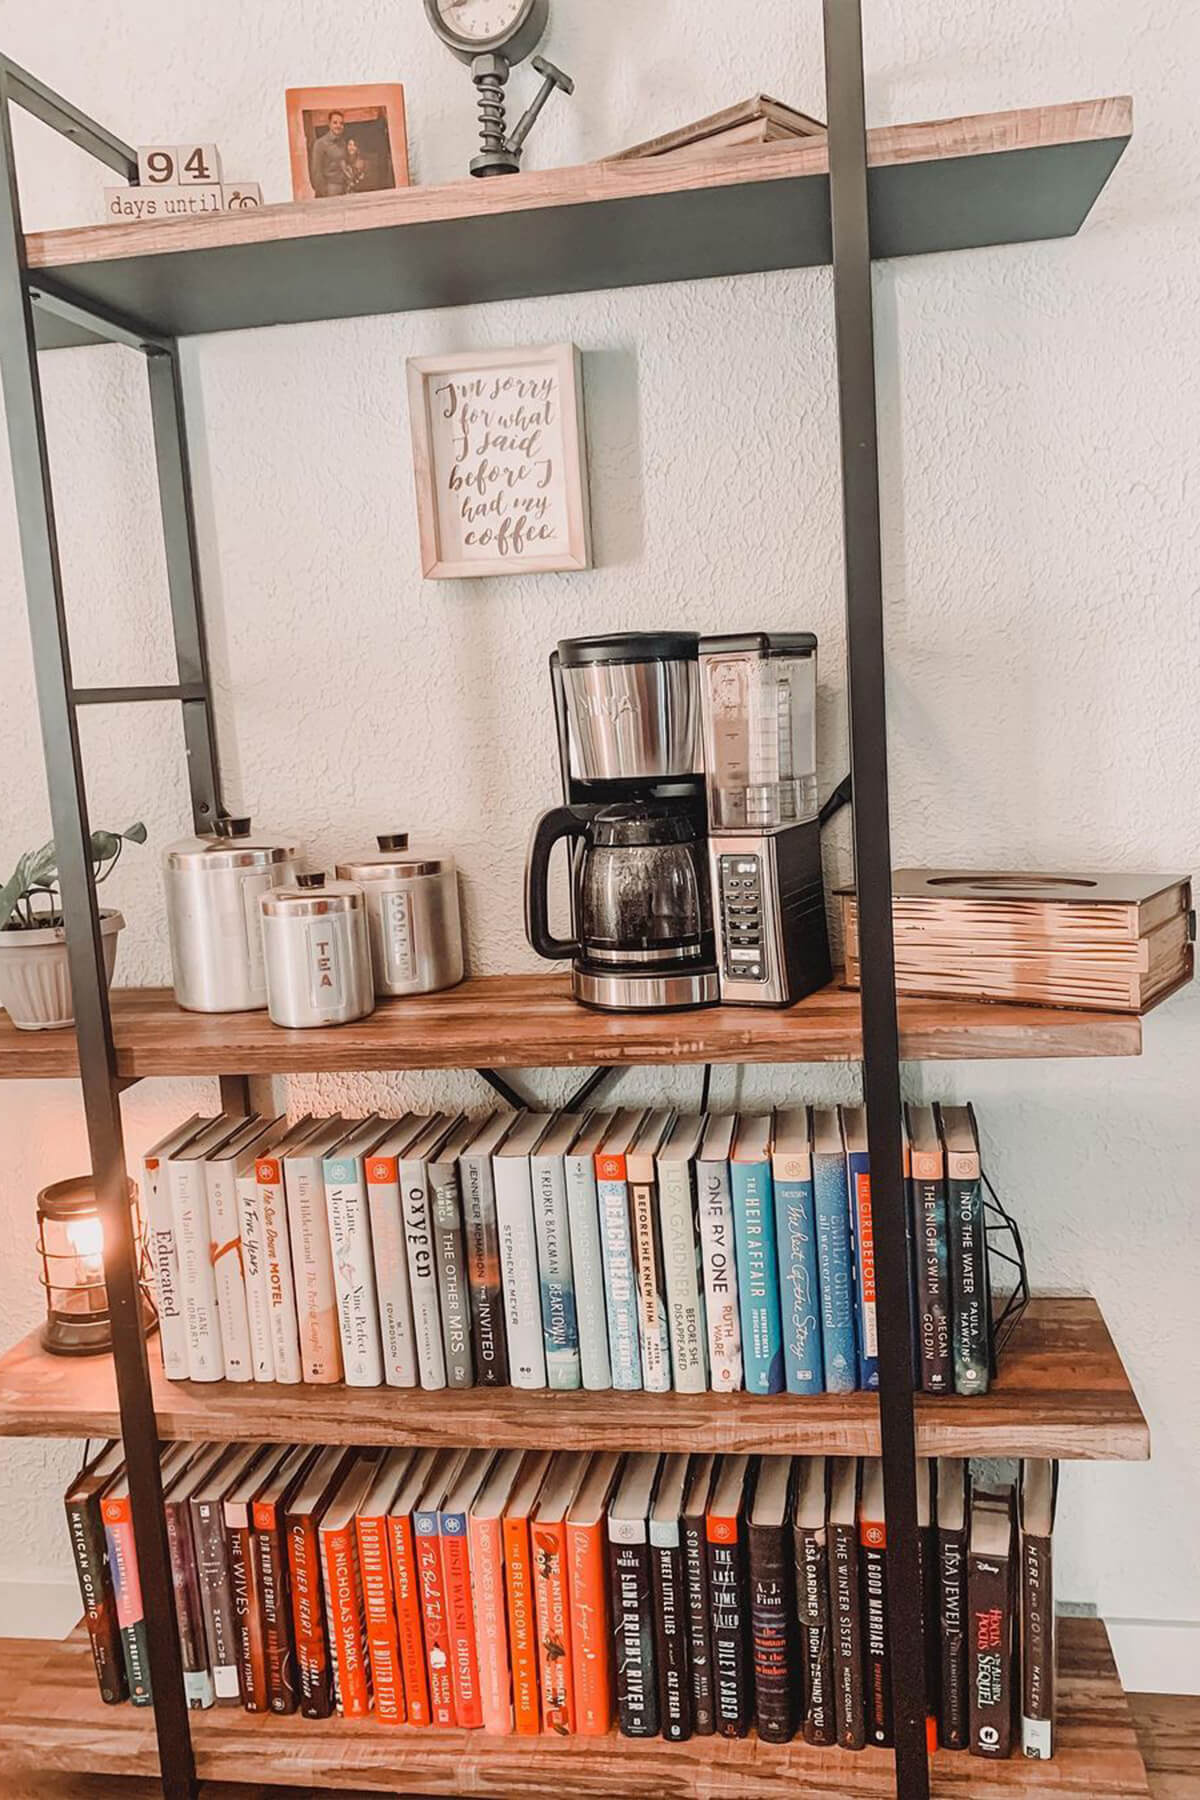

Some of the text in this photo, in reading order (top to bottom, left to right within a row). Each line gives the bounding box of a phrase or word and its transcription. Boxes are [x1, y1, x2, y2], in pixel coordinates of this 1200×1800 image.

[146, 147, 210, 182] 94
[110, 193, 221, 218] days until
[489, 377, 556, 399] sorry
[460, 400, 553, 436] for what
[453, 429, 541, 462] I said
[449, 459, 552, 495] before I
[461, 492, 550, 522] had my
[464, 516, 555, 555] coffee
[316, 942, 333, 988] TEA
[263, 1189, 273, 1208] The
[445, 1190, 453, 1217] MARY
[469, 1163, 482, 1219] JENNIFER
[243, 1198, 259, 1275] In Five Years
[265, 1209, 276, 1226] Sun
[407, 1188, 431, 1278] oxygen
[541, 1170, 559, 1274] FREDRIK BACKMAN
[745, 1177, 765, 1297] THE HEIR AFFAIR
[860, 1201, 872, 1235] GIRL
[266, 1229, 277, 1258] Down
[637, 1193, 654, 1324] BEFORE SHE KNEW HIM
[924, 1185, 938, 1295] THE NIGHT SWIM
[960, 1191, 973, 1294] INTO THE WATER
[156, 1230, 180, 1317] Educated
[270, 1263, 282, 1308] MOTEL
[504, 1224, 518, 1325] STEPHENIE MEYER
[609, 1258, 630, 1301] READ
[711, 1253, 729, 1293] ONE
[819, 1214, 834, 1328] all we ever wanted
[863, 1240, 876, 1297] BEFORE
[443, 1232, 464, 1355] THE OTHER MRS.
[197, 1307, 209, 1336] LIANE
[342, 1294, 354, 1346] Strangers
[479, 1303, 494, 1361] INVITED
[549, 1283, 566, 1345] BEARTOWN
[722, 1306, 733, 1337] RUTH
[969, 1301, 978, 1335] PAULA
[356, 1316, 367, 1354] Perfect
[673, 1303, 687, 1371] DISAPPEARED
[686, 1308, 698, 1366] BEFORE SHE
[714, 1324, 724, 1358] WARE
[923, 1313, 934, 1360] GOLDIN
[938, 1316, 948, 1358] MEGAN
[960, 1312, 970, 1362] HAWKINS
[71, 1511, 97, 1620] MEXICAN GOTHIC
[231, 1534, 249, 1616] THE WIVES
[261, 1554, 271, 1574] KIND
[536, 1548, 548, 1572] FOR
[660, 1550, 672, 1579] SWEET
[686, 1530, 700, 1610] SOMETIMES
[714, 1549, 732, 1563] THE
[867, 1552, 880, 1560] A
[944, 1543, 961, 1576] LISA
[1027, 1545, 1039, 1587] HERE
[264, 1576, 272, 1586] OF
[293, 1526, 312, 1636] CROSS HER HEART
[398, 1558, 409, 1599] LAPENA
[551, 1552, 564, 1636] THE ANTIDOTE
[662, 1582, 674, 1612] LITTLE
[712, 1570, 736, 1584] LAST
[756, 1582, 782, 1594] A. J.
[804, 1537, 819, 1617] LISA GARDNER
[836, 1536, 852, 1657] THE WINTER SISTER
[868, 1564, 881, 1595] GOOD
[335, 1553, 358, 1671] NICHOLAS SPARKS
[511, 1561, 527, 1650] BREAKDOWN
[713, 1592, 737, 1605] TIME
[757, 1594, 781, 1605] Finn
[664, 1614, 676, 1635] LIES
[692, 1625, 704, 1648] LIE
[712, 1613, 719, 1626] I
[869, 1599, 884, 1656] MARRIAGE
[989, 1608, 1002, 1647] HOCUS
[241, 1626, 253, 1692] TARRYN FISHER
[618, 1574, 644, 1711] LONG BRIGHT RIVER
[441, 1675, 451, 1704] HELEN
[520, 1682, 530, 1711] PARIS
[668, 1670, 678, 1688] CAZ
[716, 1640, 738, 1719] RILEY SAGER
[843, 1667, 854, 1721] MEGAN COLLINS
[976, 1653, 996, 1709] SEQUEL
[669, 1690, 680, 1719] FREAR
[812, 1707, 824, 1727] YOU
